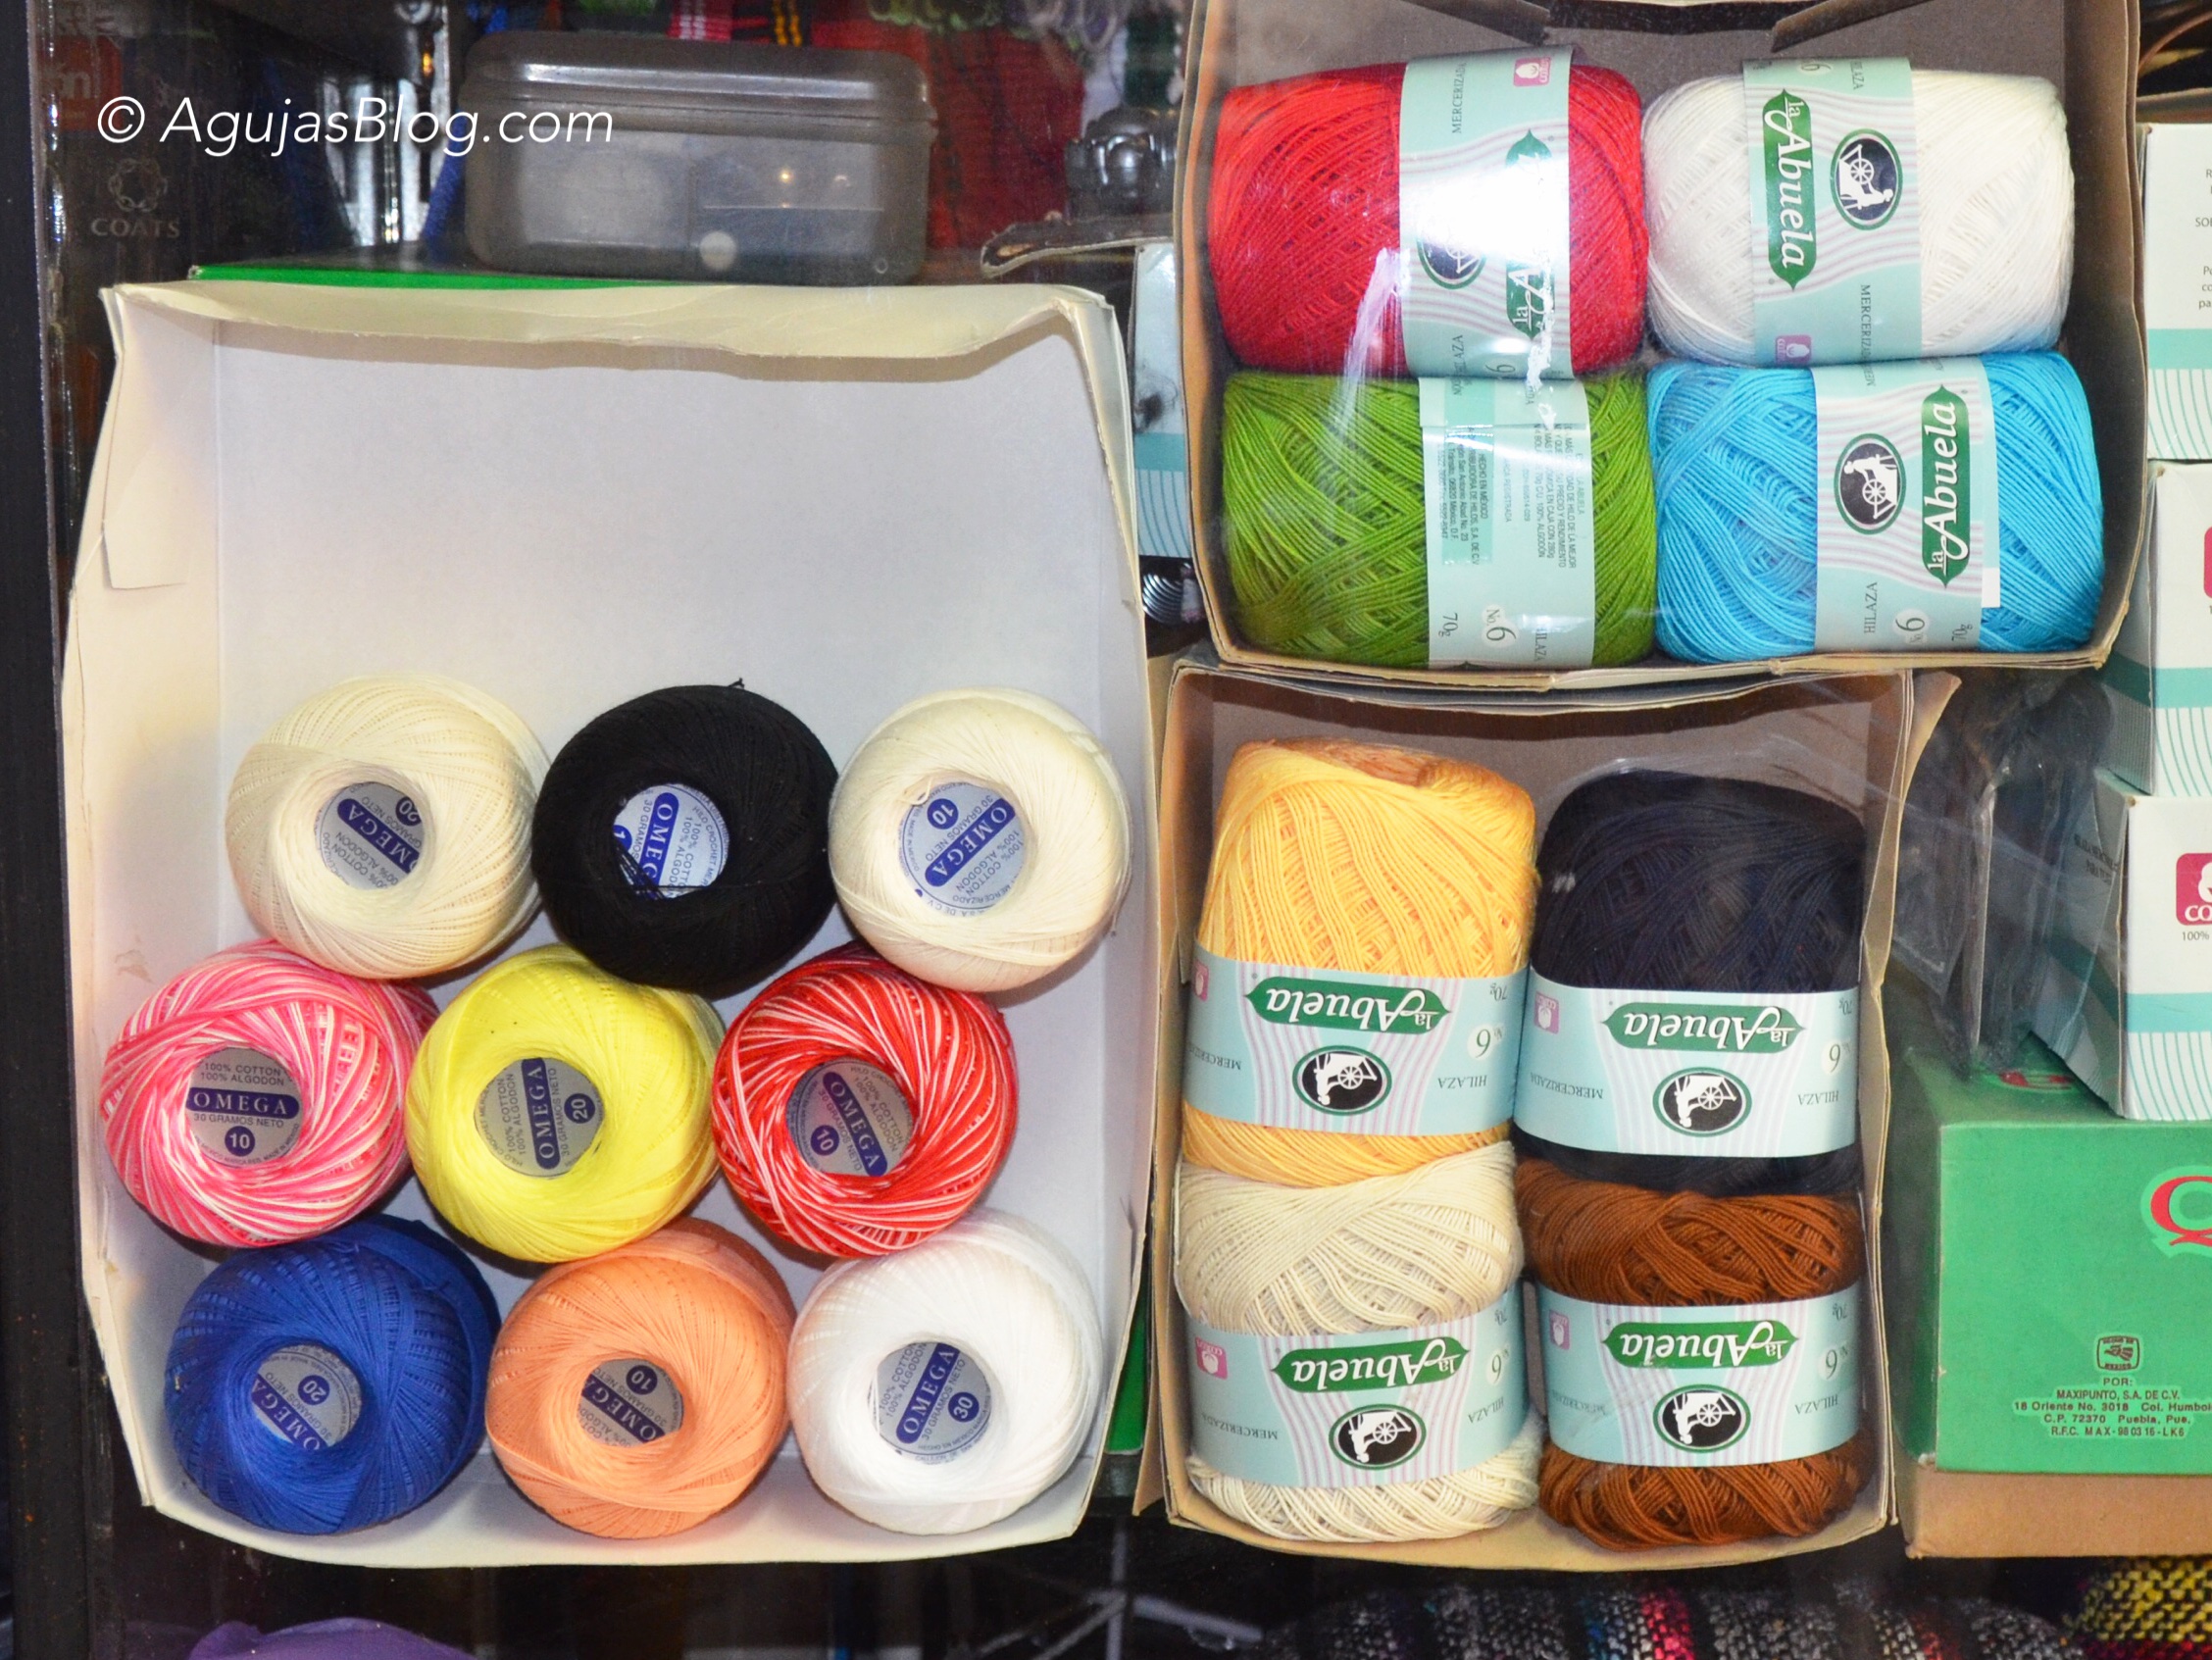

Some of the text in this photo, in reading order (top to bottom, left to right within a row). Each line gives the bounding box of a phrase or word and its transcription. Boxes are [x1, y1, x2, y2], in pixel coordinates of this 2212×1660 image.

[1764, 108, 1814, 269] Abuela
[90, 218, 180, 238] COATS
[1479, 454, 1487, 478] HECHO
[1924, 402, 1969, 561] Abuela
[1556, 484, 1566, 511] PRECIO
[1568, 544, 1577, 569] MEJOR
[1864, 581, 1878, 634] HILAZA
[1485, 626, 1517, 642] 6
[1895, 617, 1926, 632] 6
[642, 799, 653, 813] 30
[931, 804, 954, 825] 10
[361, 796, 423, 849] GRAMOS NETO
[679, 817, 693, 843] 100%
[687, 823, 702, 849] 100%
[925, 794, 993, 862] 30 GRAMOS NETO
[335, 831, 378, 869] ALGODON
[642, 803, 674, 879] OMEG
[706, 825, 719, 866] CROCHET
[931, 806, 1008, 878] OMEGA
[332, 843, 369, 876] COTTON
[956, 830, 1020, 891] 100% ALGODON
[965, 841, 1025, 896] 100% COTTON
[952, 884, 1012, 904] MERCERIZADO
[2182, 931, 2210, 941] 100%
[1488, 981, 1508, 1001] 70g
[1266, 988, 1432, 1032] la Abuela
[1623, 1007, 1790, 1050] la Abuela
[1475, 1029, 1491, 1059] 6
[204, 1063, 281, 1077] 100% COTTON
[1829, 1044, 1841, 1073] 6
[200, 1072, 284, 1086] 100% ALGODON
[548, 1068, 560, 1096] NETO
[1436, 1075, 1488, 1089] HILAZA
[1530, 1071, 1604, 1100] MERCERIZADA
[193, 1091, 287, 1115] OMEGA
[571, 1098, 588, 1121] 20
[863, 1076, 904, 1144] 100% COTTON
[1797, 1090, 1839, 1106] HILAZA
[193, 1113, 284, 1129] 30 GRAMOS NETO
[497, 1079, 516, 1152] 100% COTTON
[506, 1074, 527, 1156] 100% ALGODON
[528, 1066, 556, 1159] OMEGA
[552, 1096, 568, 1144] GRAMOS
[830, 1082, 880, 1169] OMEGA
[229, 1132, 251, 1150] 10
[816, 1129, 834, 1151] 10
[827, 1101, 851, 1142] GRAMOS
[846, 1141, 863, 1172] NETO
[870, 1103, 898, 1152] ALGODON
[1620, 1322, 1784, 1368] la Abuela
[879, 1343, 918, 1410] 100% COTTON
[1291, 1339, 1458, 1390] la Abuela
[1491, 1352, 1503, 1384] 6
[1825, 1348, 1838, 1378] 6
[265, 1372, 289, 1394] NETO
[303, 1380, 327, 1402] 20
[630, 1370, 652, 1390] 10
[886, 1342, 928, 1418] 100% ALGODON
[902, 1350, 955, 1434] OMEGA
[2102, 1377, 2134, 1386] POR:
[619, 1385, 654, 1416] GRAMOS
[922, 1359, 966, 1440] 30 GRAMOS NETO
[953, 1396, 973, 1419] 30
[1794, 1392, 1838, 1416] HILAZA
[2015, 1402, 2028, 1411] 18
[2032, 1401, 2074, 1412] Oriente
[2078, 1402, 2096, 1412] No.
[2101, 1402, 2130, 1412] 3018
[2141, 1402, 2164, 1412] Col.
[2056, 1389, 2180, 1401] MAXIPUNTO, S.A. DE C.V.
[252, 1379, 321, 1451] OMEGA
[286, 1393, 322, 1430] GRAMOS
[654, 1415, 668, 1427] 30
[1468, 1396, 1505, 1424] HILAZA
[2043, 1414, 2190, 1425] C.P. 72370 Puebla, Pue.
[1200, 1412, 1279, 1440] MERCERIZADA
[2051, 1427, 2079, 1436] R.F.C.
